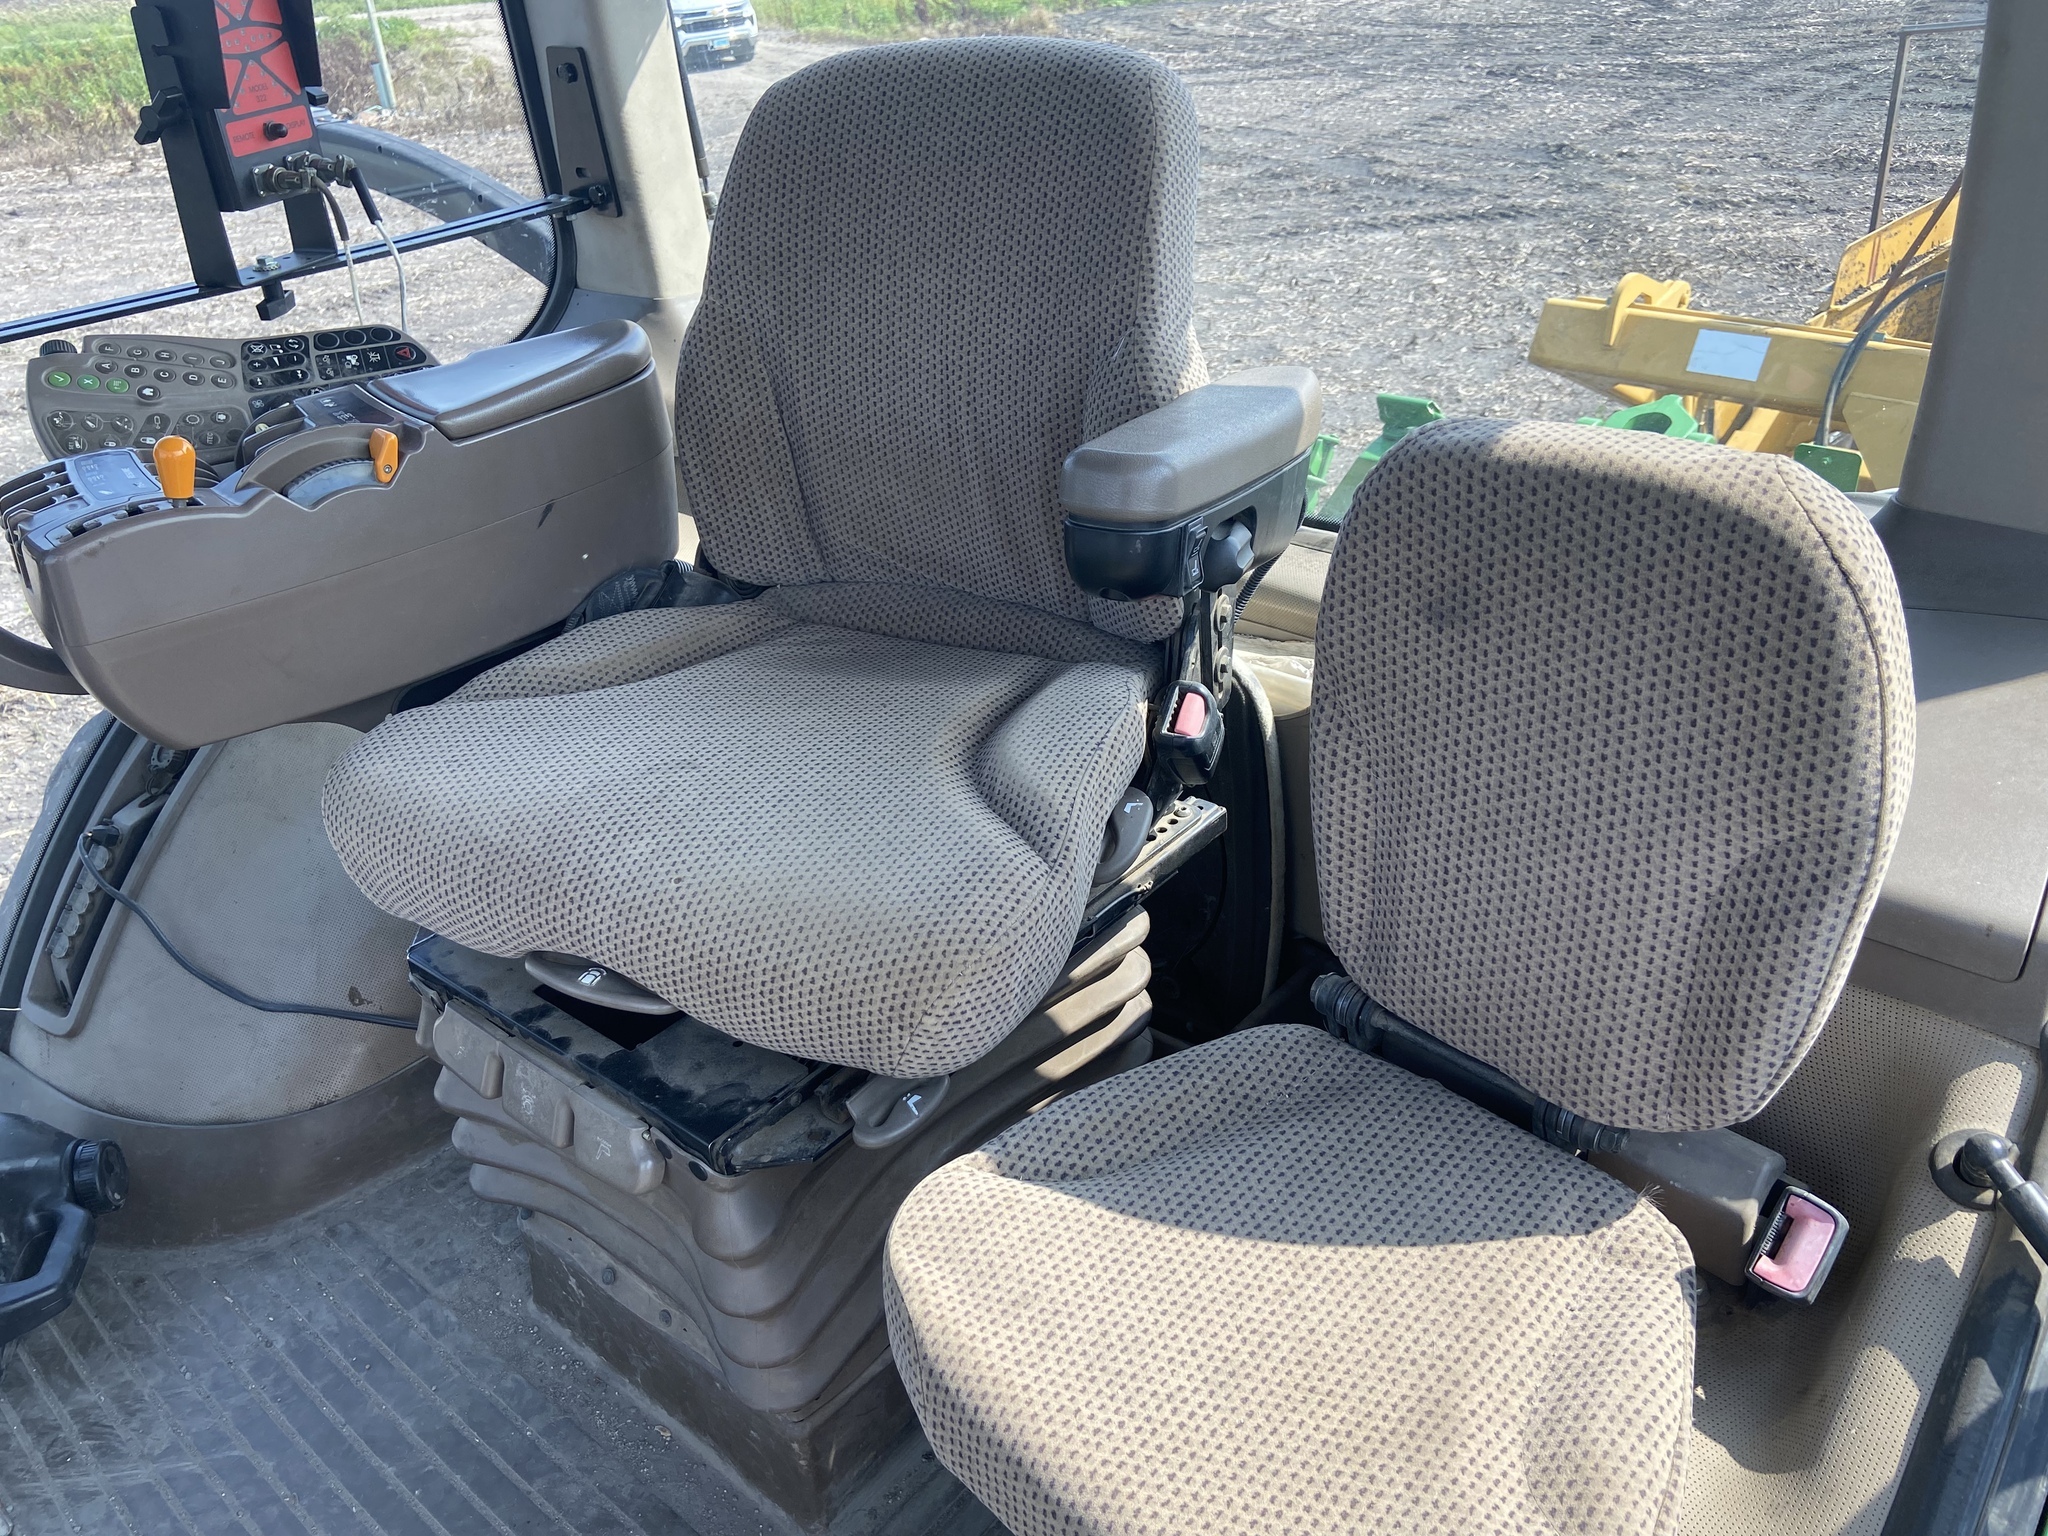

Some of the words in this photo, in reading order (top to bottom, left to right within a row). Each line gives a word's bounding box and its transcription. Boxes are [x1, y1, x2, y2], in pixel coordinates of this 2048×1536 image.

[248, 82, 269, 93] MODEL
[255, 93, 267, 103] 322
[232, 131, 256, 143] REMOTE
